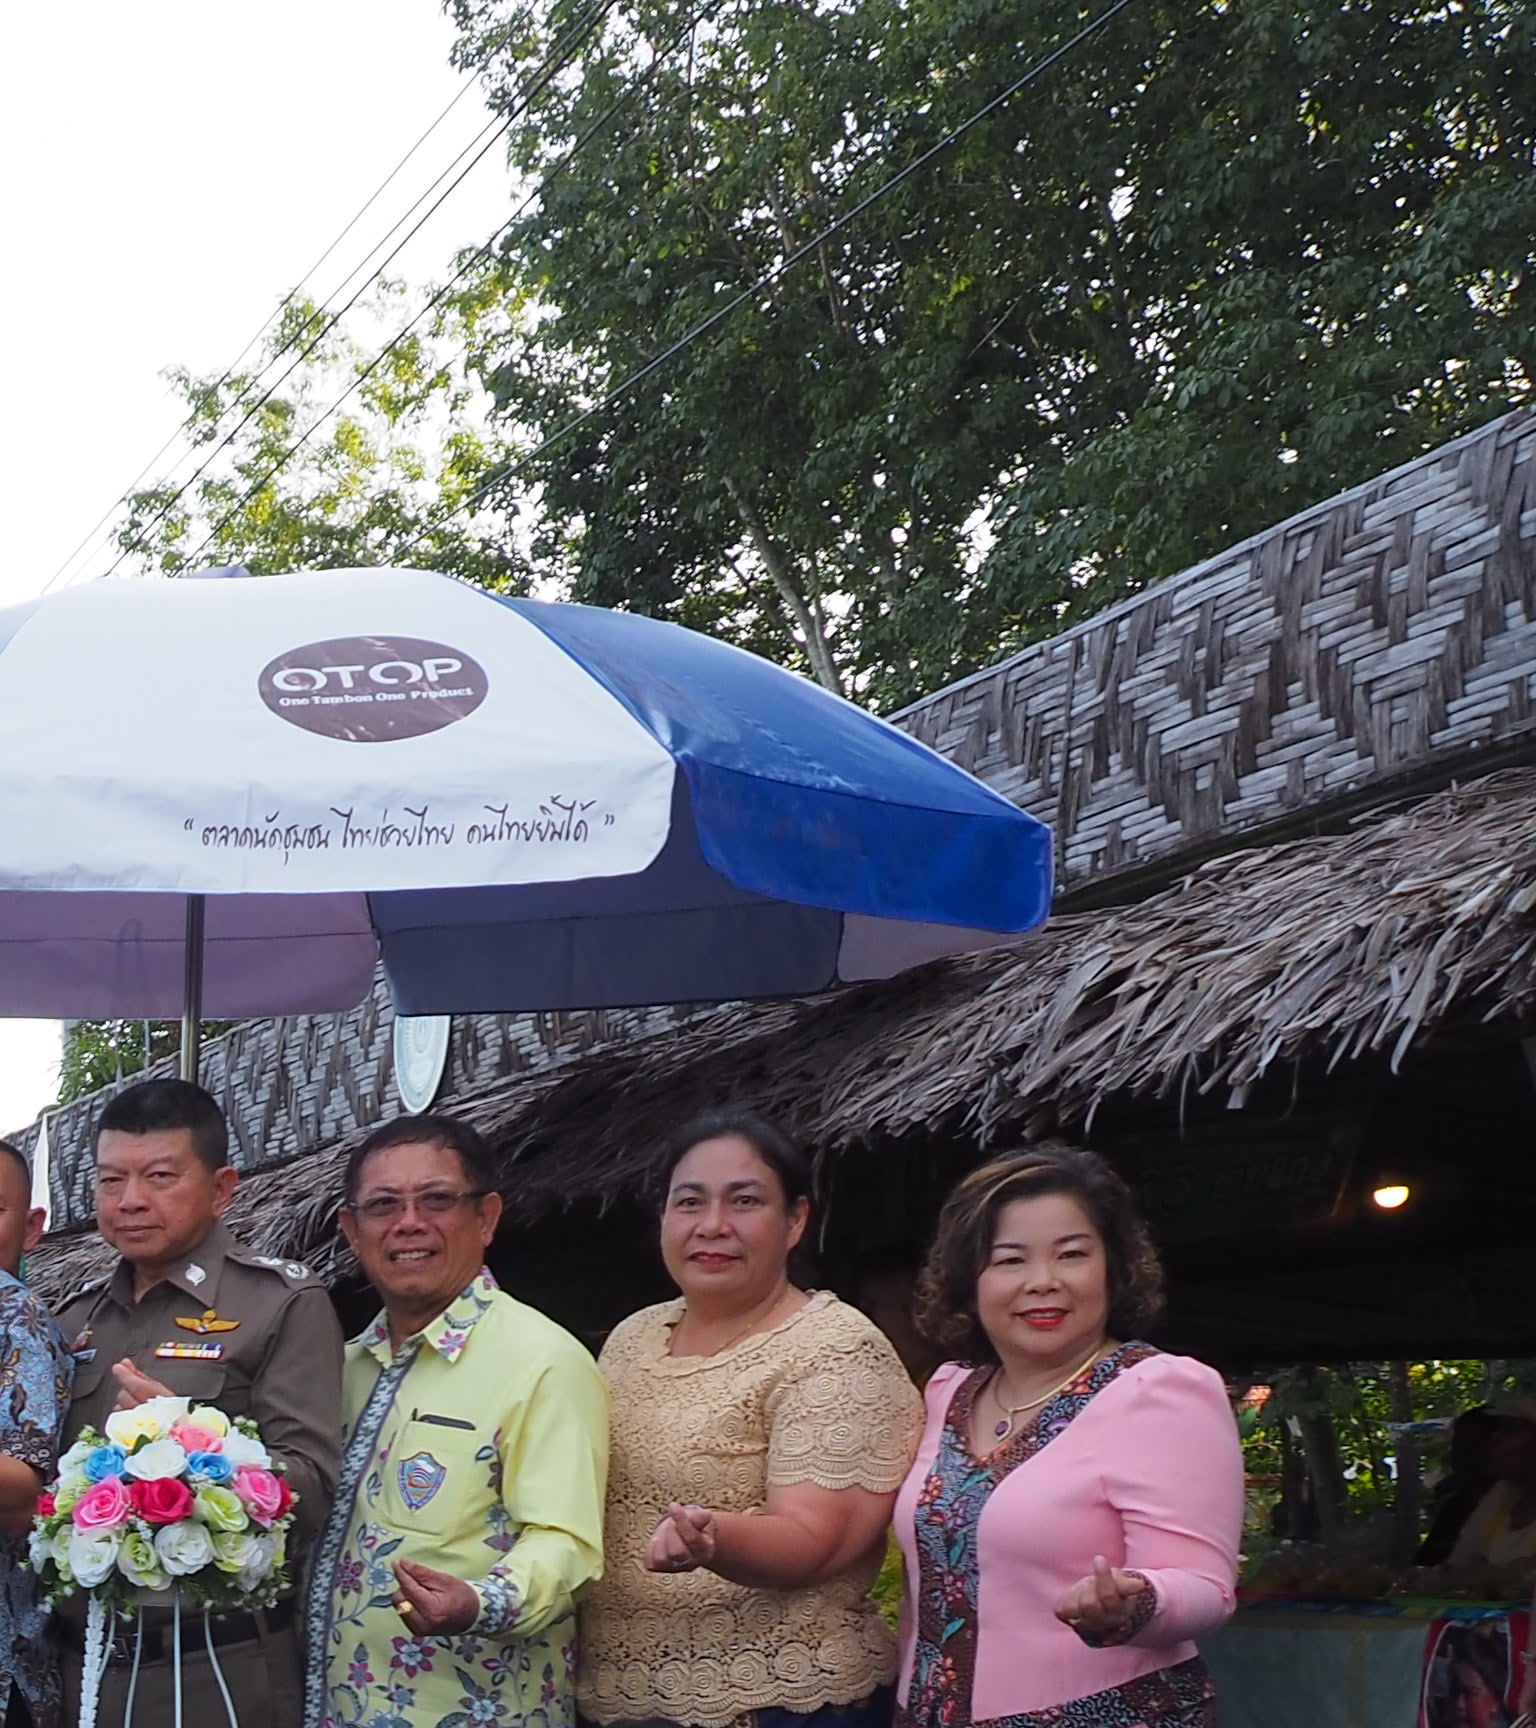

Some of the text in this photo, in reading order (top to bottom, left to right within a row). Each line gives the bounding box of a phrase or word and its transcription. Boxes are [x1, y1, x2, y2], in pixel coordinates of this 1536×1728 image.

[272, 657, 463, 692] OTOP
[279, 686, 475, 707] One Tambon One Product
